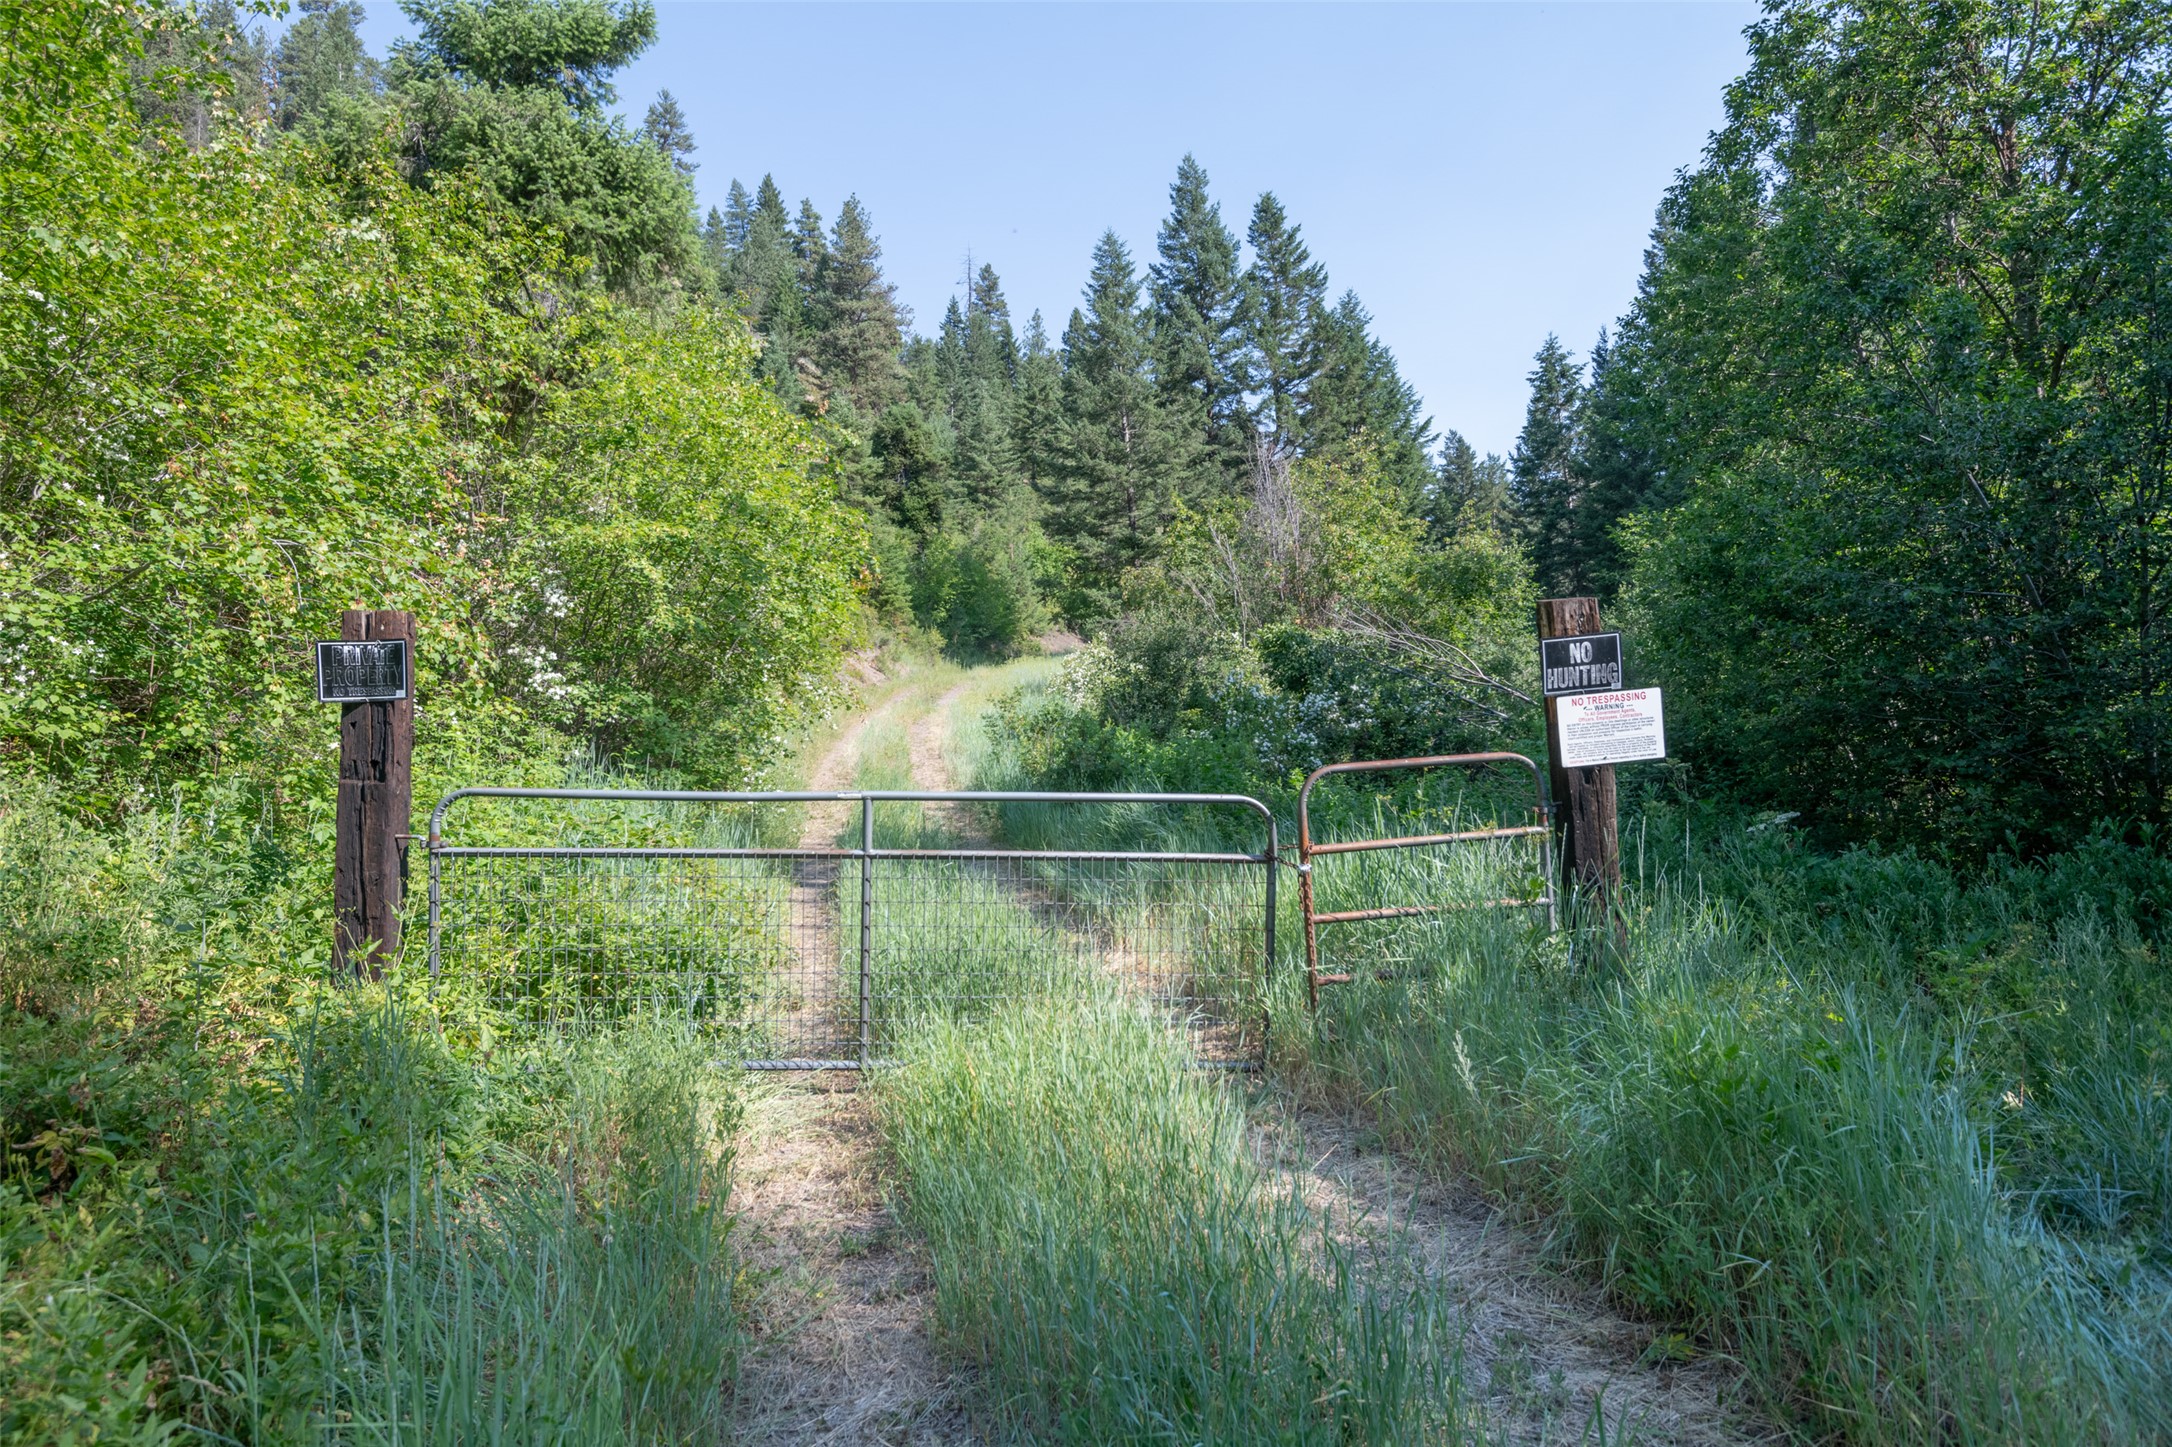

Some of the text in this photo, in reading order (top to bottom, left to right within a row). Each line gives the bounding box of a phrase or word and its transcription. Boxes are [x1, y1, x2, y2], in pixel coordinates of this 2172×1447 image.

[332, 645, 395, 666] PRIVATE
[1570, 642, 1593, 664] NO
[323, 665, 401, 687] PROPERTY
[1547, 662, 1618, 689] HUNTING
[333, 687, 396, 697] NO TRESPASSING
[1572, 692, 1647, 707] NO TRESPASSING
[1594, 703, 1625, 711] WARNING
